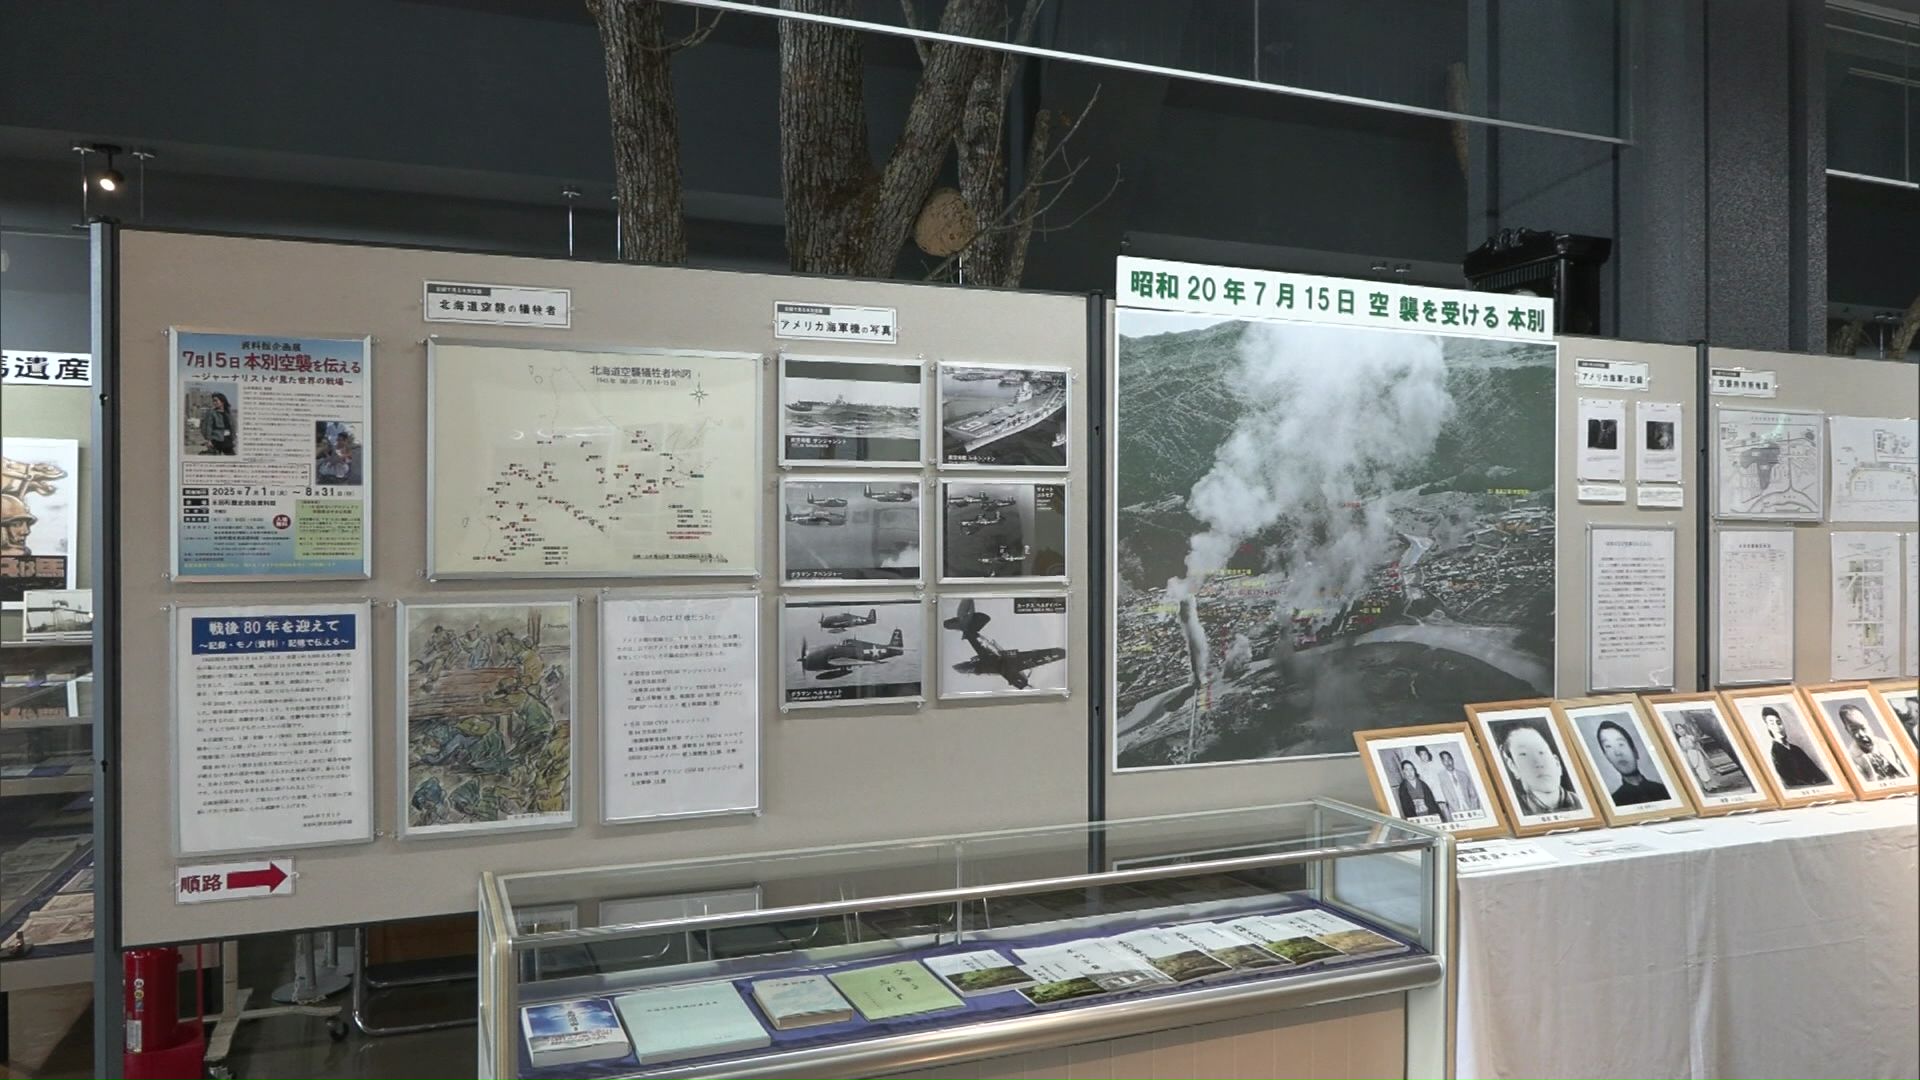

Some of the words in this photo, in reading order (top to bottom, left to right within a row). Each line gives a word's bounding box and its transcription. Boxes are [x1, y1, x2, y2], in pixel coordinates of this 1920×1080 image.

[439, 299, 557, 316] 北海道空襲の犠牲者
[780, 320, 891, 337] アメリカ海軍機の写真
[183, 351, 240, 370] 7月15日
[244, 353, 361, 374] 本別空襲を伝える
[180, 873, 223, 894] 順路
